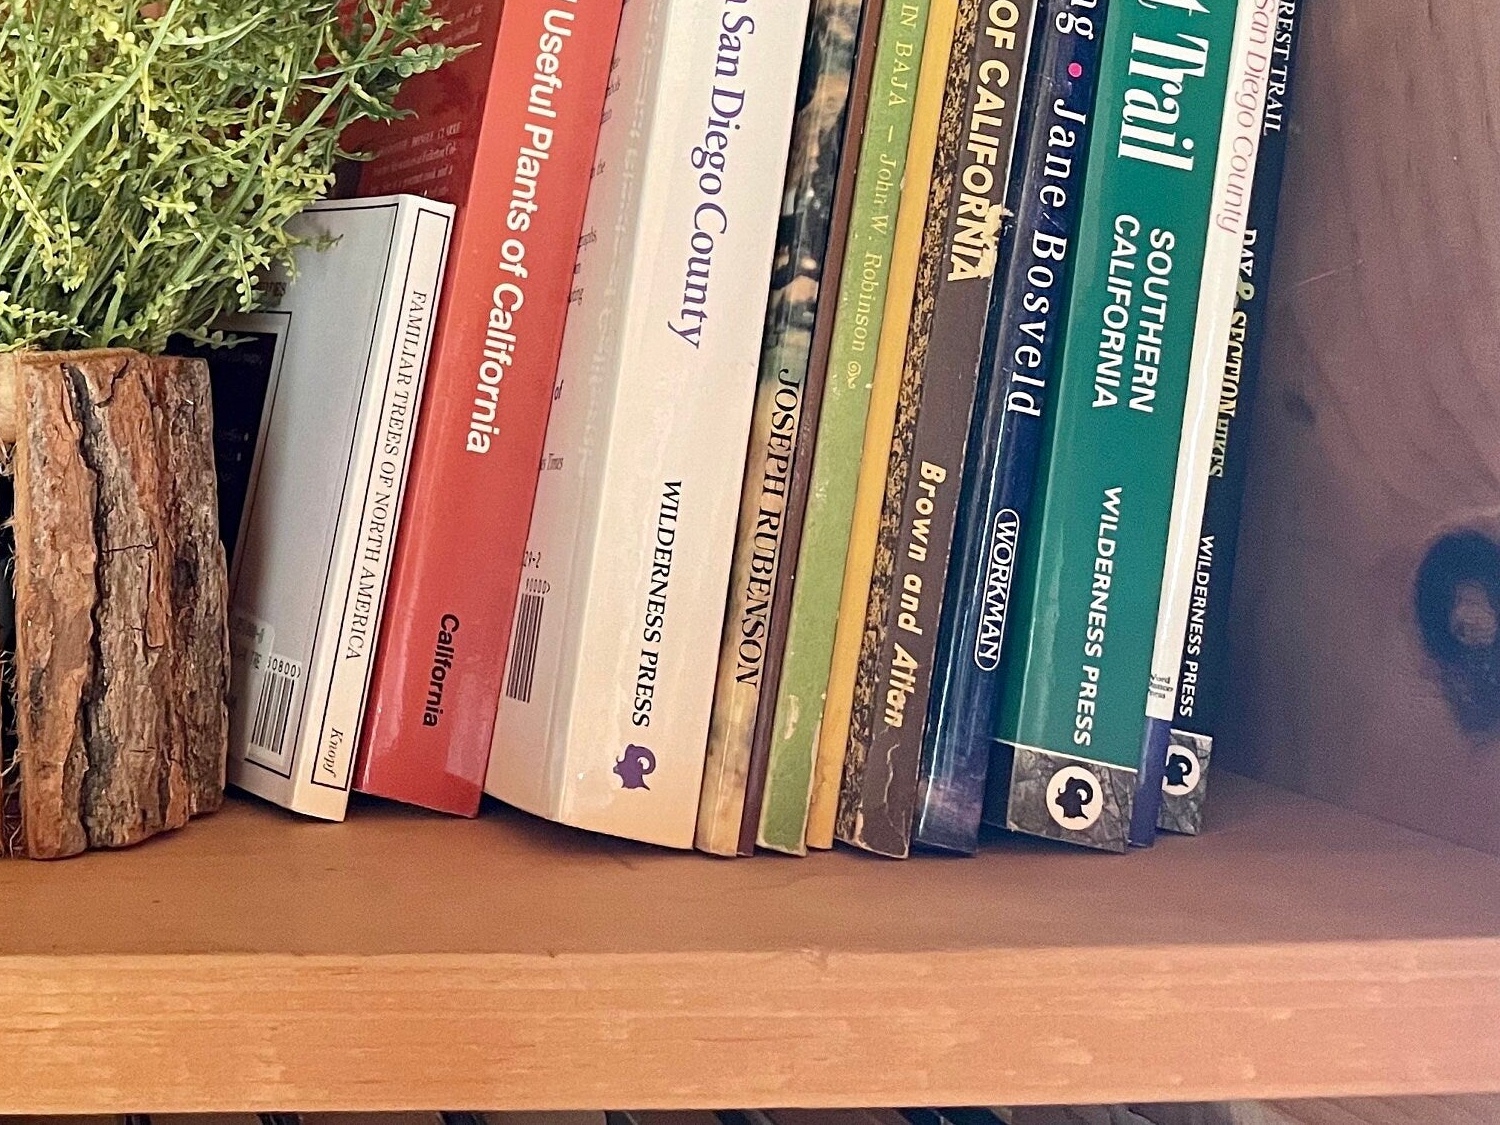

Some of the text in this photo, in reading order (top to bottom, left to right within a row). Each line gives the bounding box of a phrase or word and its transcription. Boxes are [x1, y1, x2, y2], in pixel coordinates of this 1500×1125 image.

[528, 10, 574, 117] Useful
[715, 12, 754, 77] San
[900, 3, 919, 29] IN
[986, 0, 1019, 49] OF
[889, 41, 913, 106] BAJA
[1118, 33, 1208, 170] Trail
[1236, 51, 1267, 127] Diego
[1264, 65, 1288, 136] TRAIL
[507, 124, 553, 231] Plants
[691, 86, 745, 195] Diego
[874, 154, 896, 204] John
[948, 60, 1009, 281] CALIFORNIA
[1217, 136, 1253, 234] County
[500, 239, 527, 278] of
[668, 203, 727, 349] County
[869, 215, 889, 240] W.
[1004, 99, 1086, 416] Jane Bosveld
[852, 251, 882, 351] Robinson
[1092, 215, 1140, 407] CALIFORNIA
[1129, 229, 1175, 412] SOUTHERN
[467, 283, 523, 453] California
[347, 291, 426, 659] FAMILIAR TREES OF NORTH AMERICA
[737, 369, 801, 688] JOSEPH RUBENSON
[633, 482, 681, 727] WILDERNESS PRESS
[884, 461, 946, 727] Brown and Allan
[981, 521, 1017, 660] WORKMAN
[1074, 488, 1122, 745] WILDERNESS PRESS
[1180, 535, 1214, 717] WILDERNESS PRESS
[423, 614, 459, 726] California
[323, 728, 343, 777] Knopf
